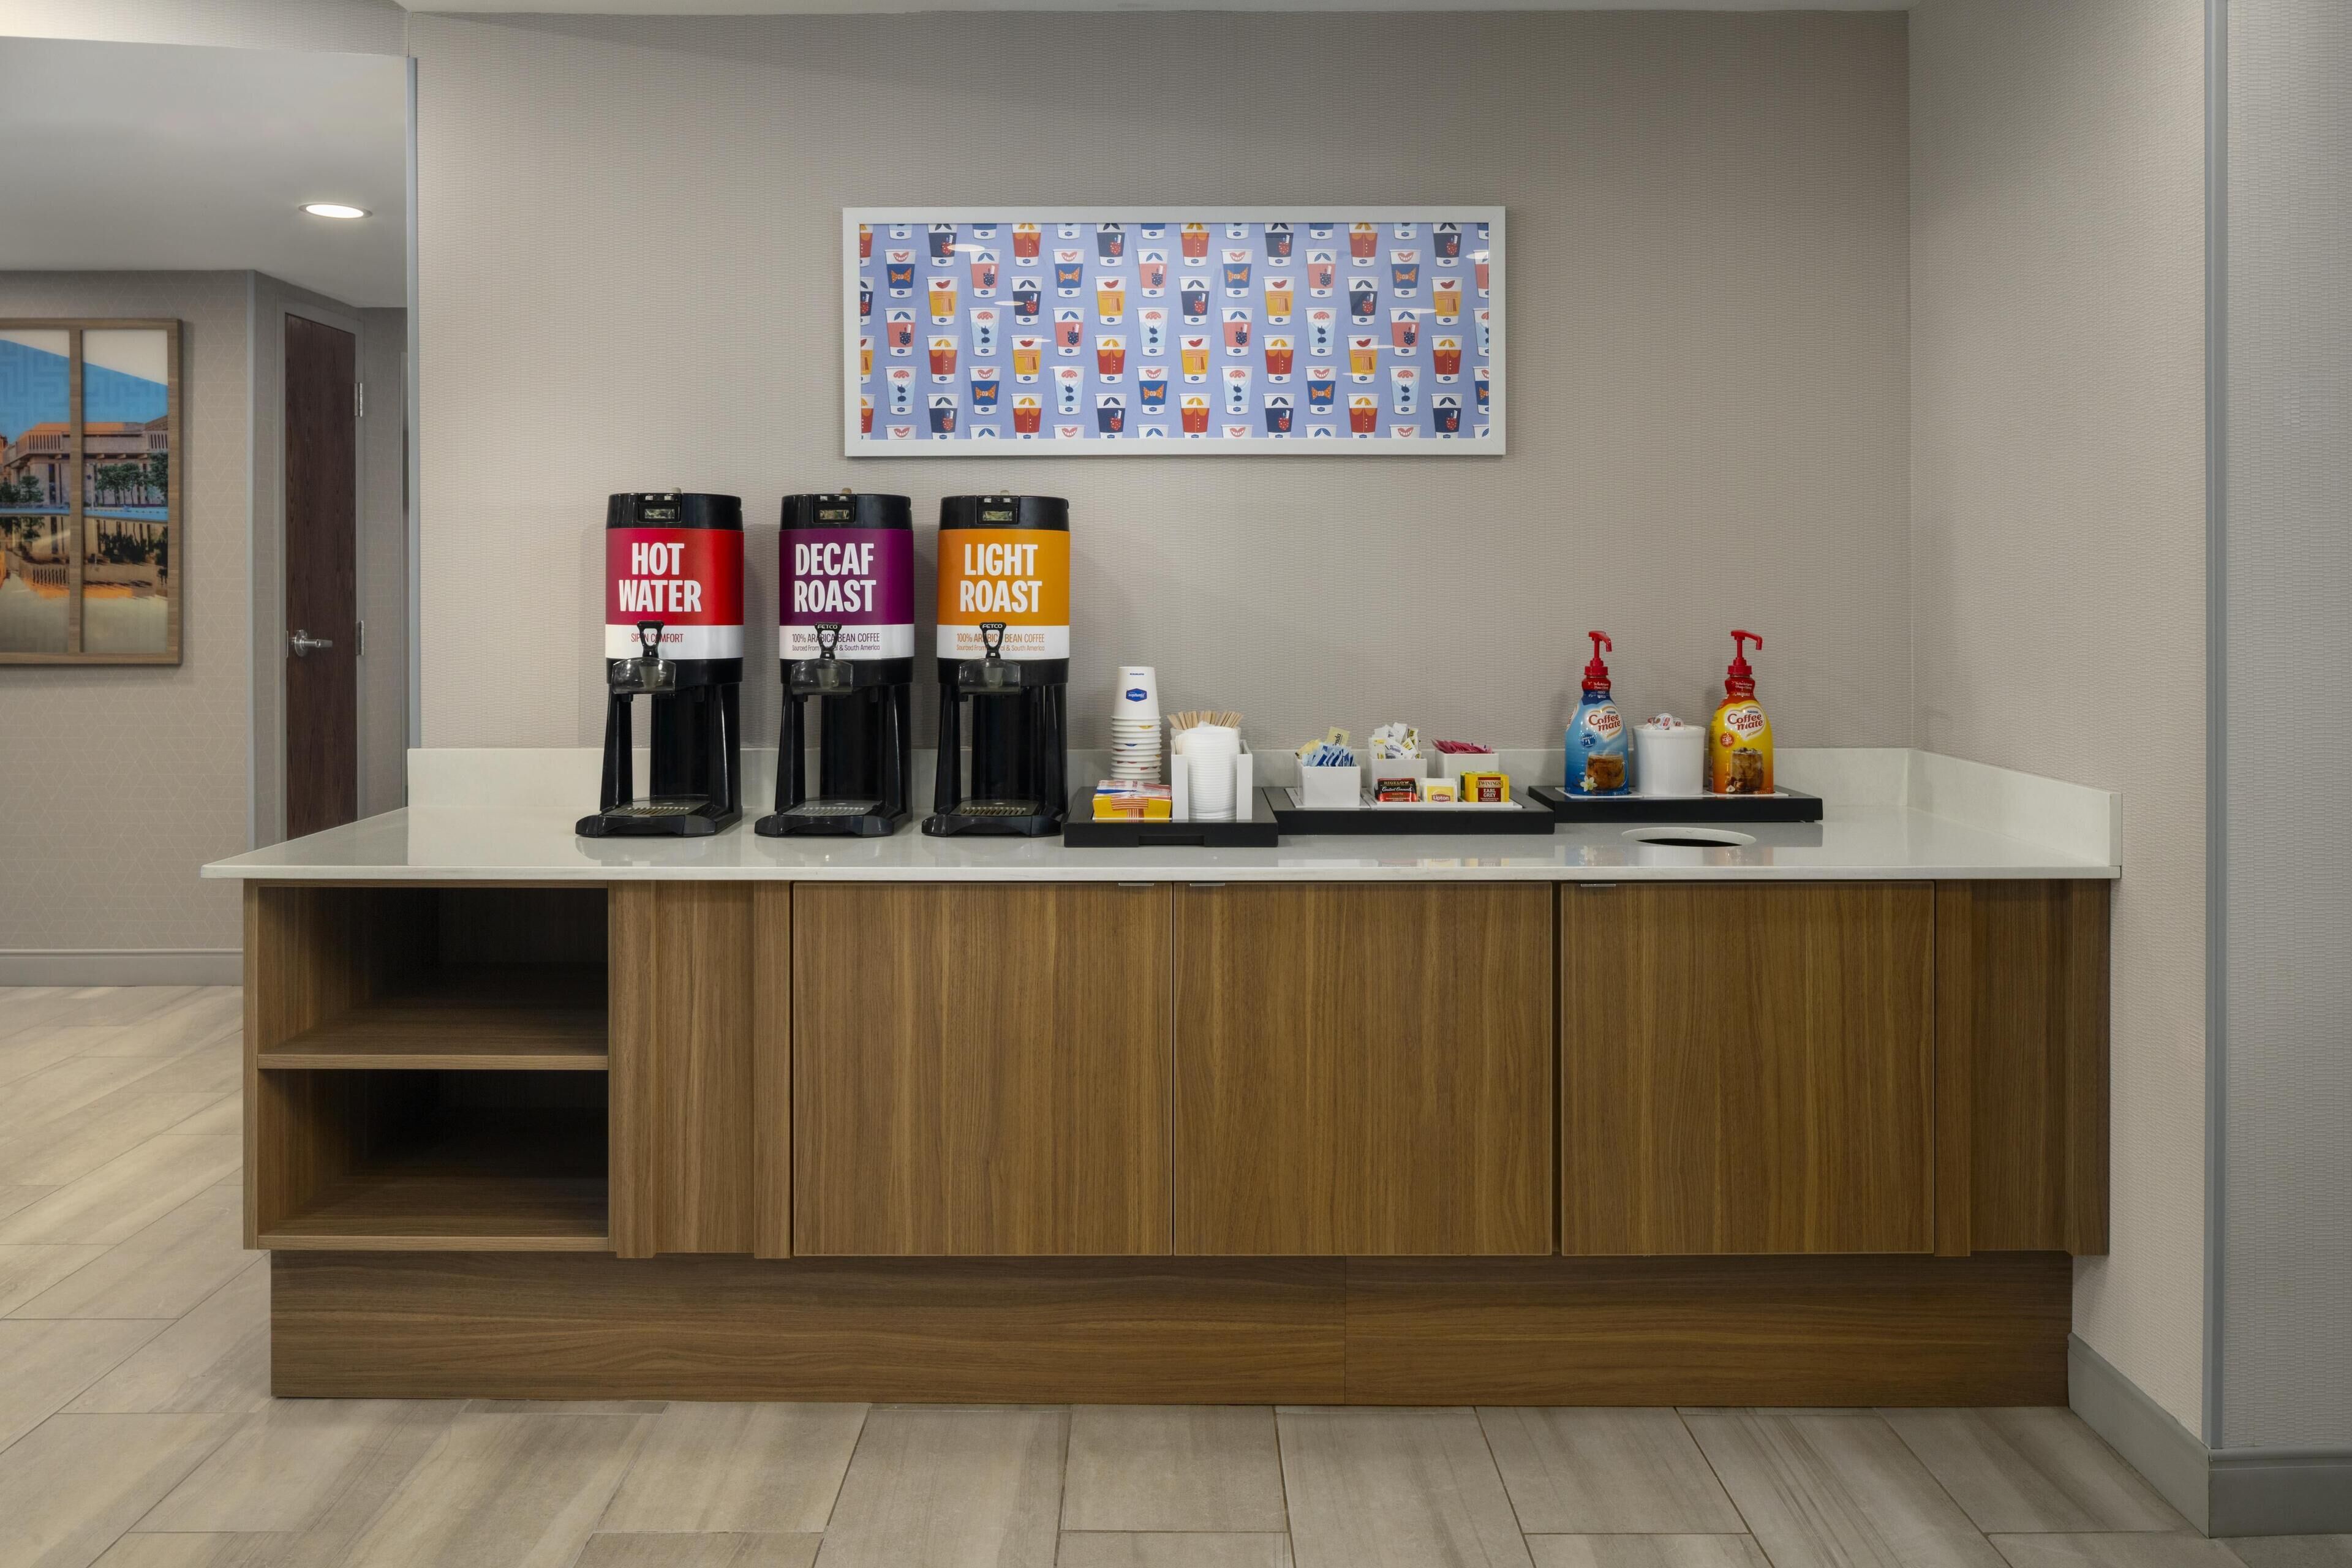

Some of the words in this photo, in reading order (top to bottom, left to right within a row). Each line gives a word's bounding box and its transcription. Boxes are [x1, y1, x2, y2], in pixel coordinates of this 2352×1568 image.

[631, 542, 685, 575] HOT
[796, 543, 874, 575] DECAF
[965, 543, 1038, 576] LIGHT
[618, 579, 703, 612] WATER
[794, 579, 876, 613] ROAST
[960, 580, 1042, 613] ROAST
[631, 633, 640, 643] SIP
[650, 633, 684, 643] CMFORT
[792, 633, 806, 643] 100%
[837, 633, 856, 643] BEAN
[858, 633, 880, 642] COFFEE
[957, 633, 972, 643] 100%
[1005, 633, 1022, 643] BEAN
[1024, 633, 1045, 643] COFFEE
[1588, 714, 1619, 726] Coffee
[1598, 720, 1621, 731] mate
[1727, 714, 1762, 725] Coffee
[1737, 720, 1763, 731] mate
